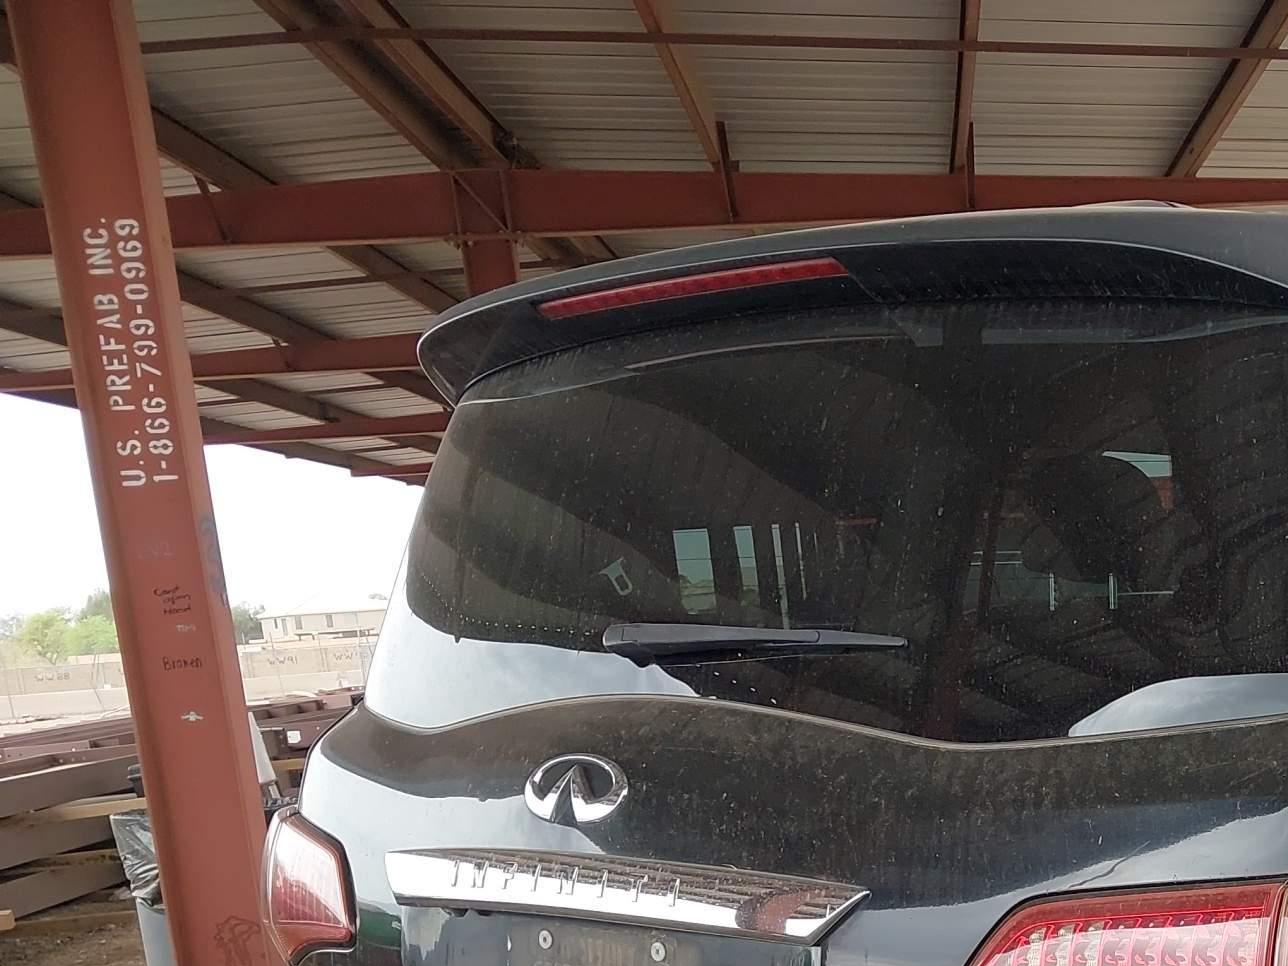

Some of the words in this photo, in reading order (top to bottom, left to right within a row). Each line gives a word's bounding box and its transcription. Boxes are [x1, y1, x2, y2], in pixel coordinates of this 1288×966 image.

[83, 217, 115, 275] INC.
[94, 294, 136, 411] PREFAB
[114, 218, 179, 482] 1-866-799-0969
[116, 430, 146, 487] U.S.
